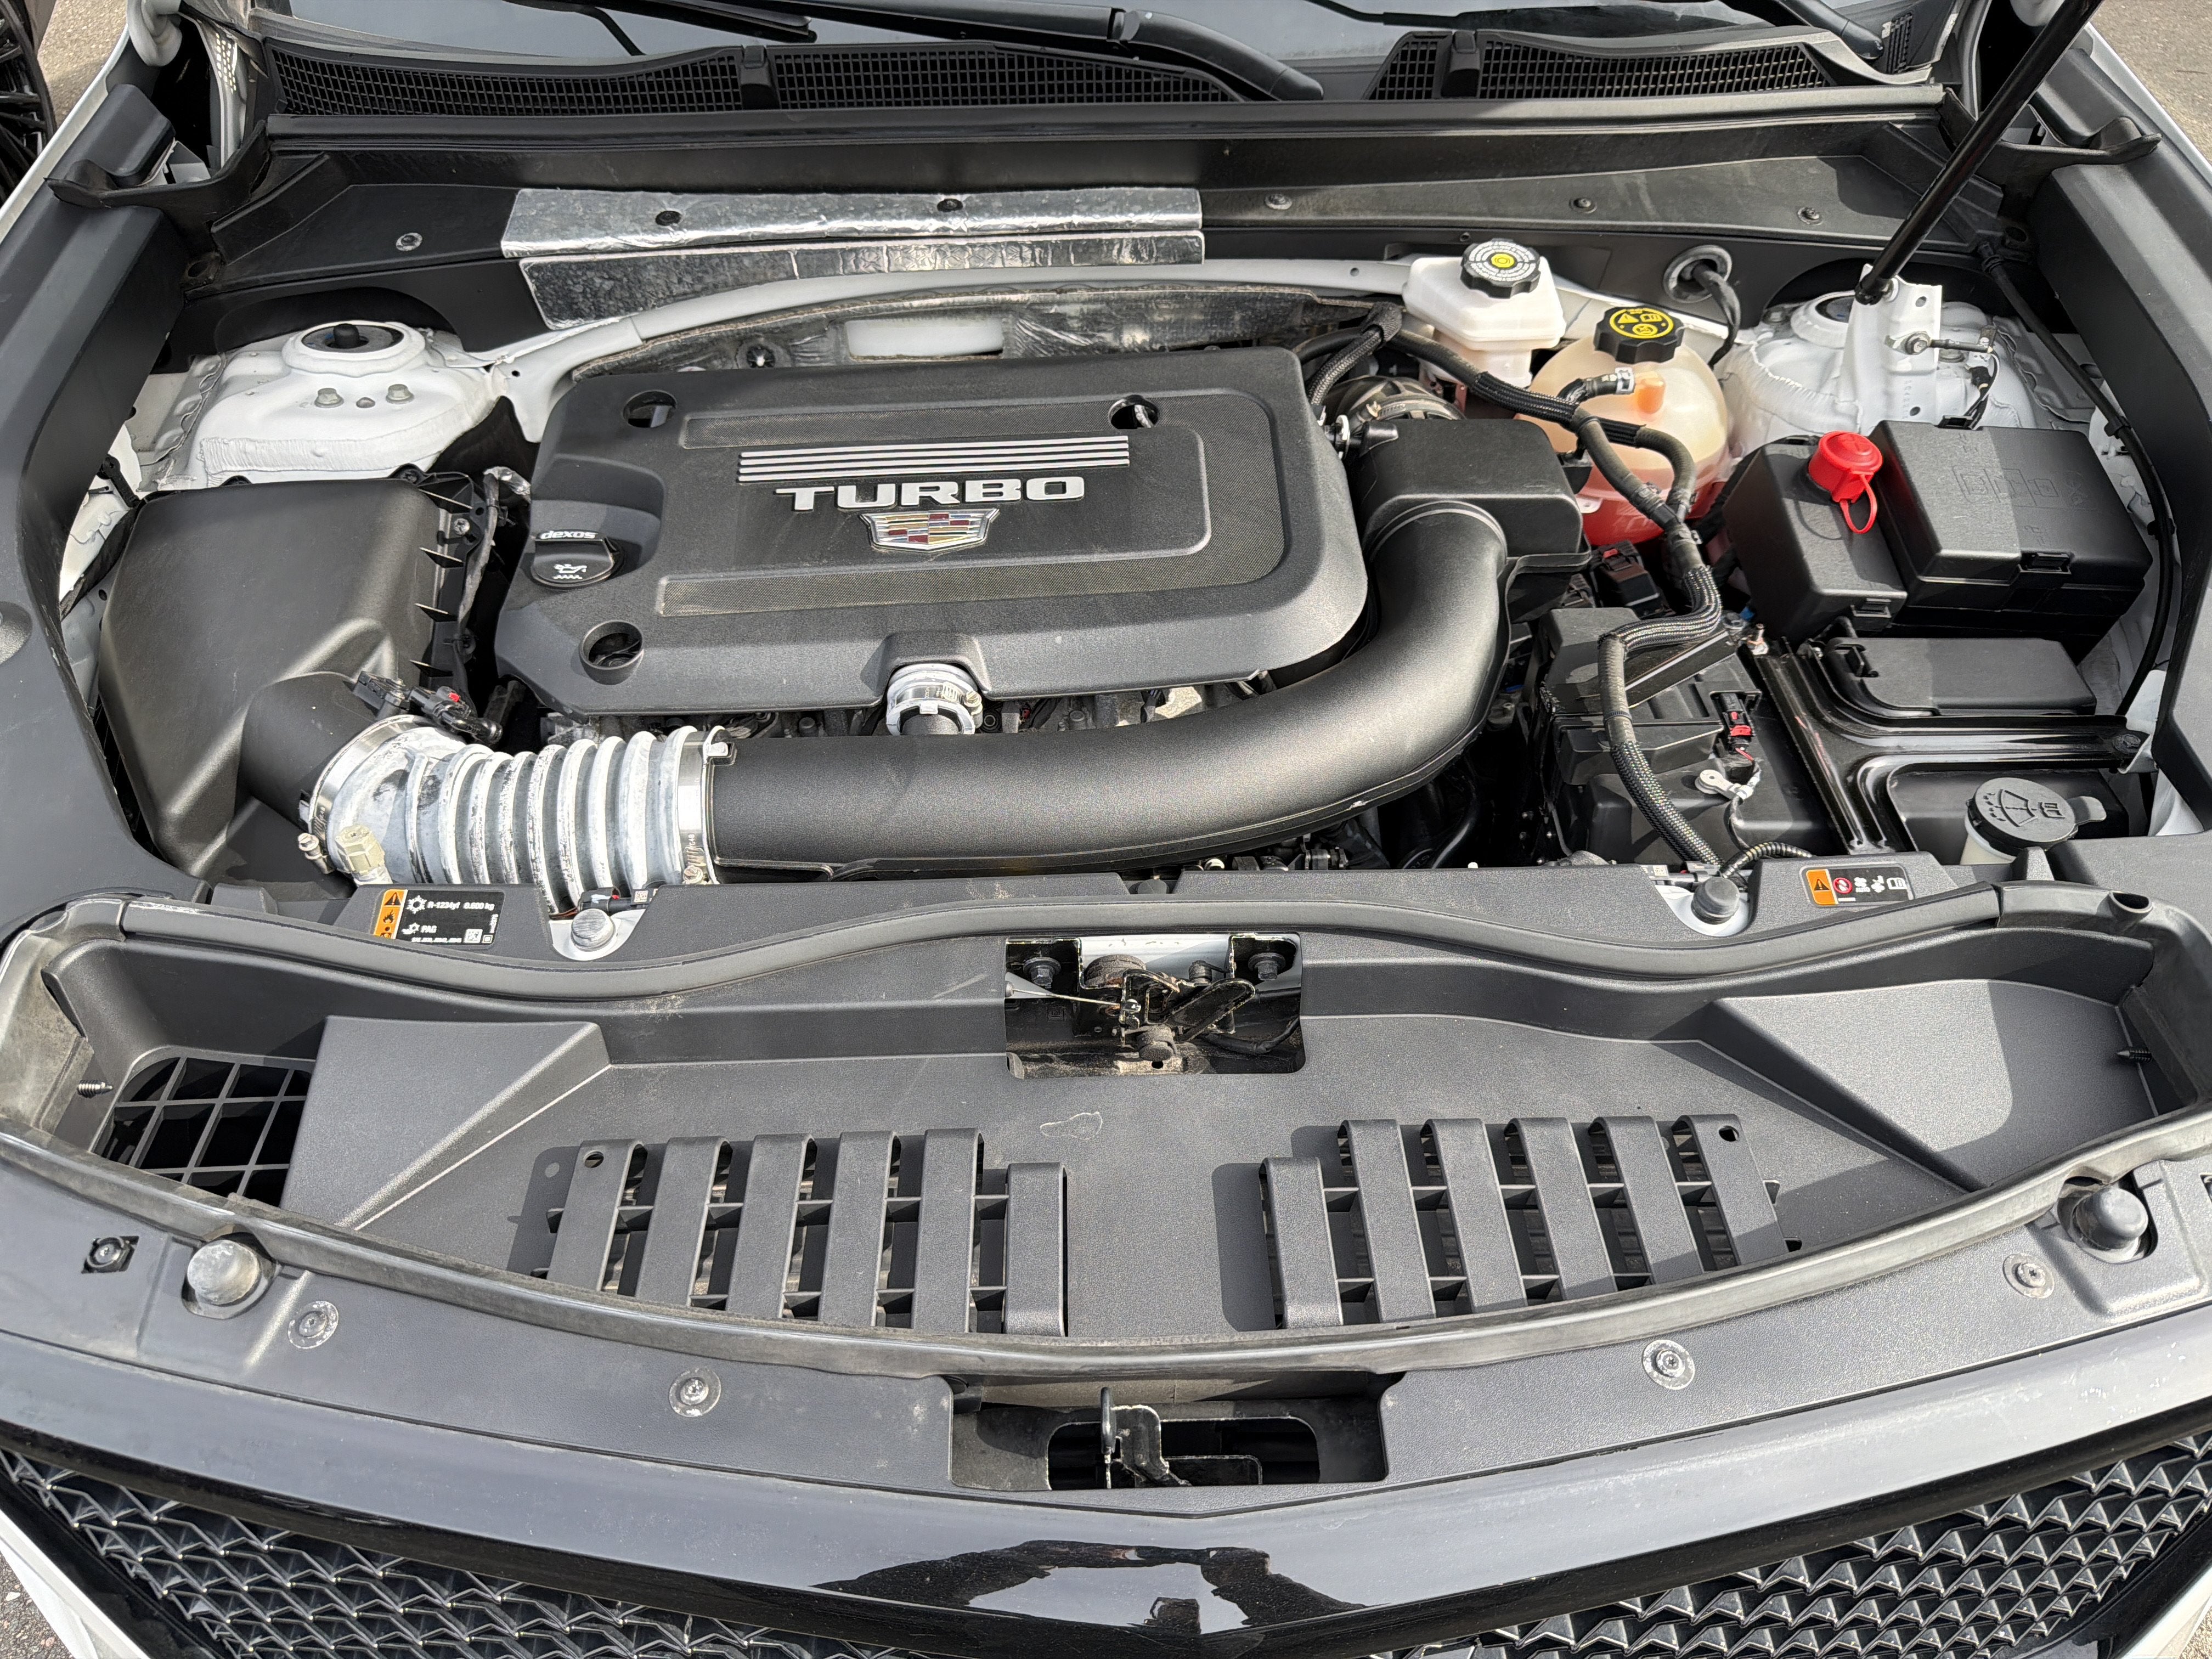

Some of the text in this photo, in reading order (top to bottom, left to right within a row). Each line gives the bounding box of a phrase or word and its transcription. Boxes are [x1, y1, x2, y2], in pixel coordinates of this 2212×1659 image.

[775, 476, 1085, 511] TURBO
[540, 531, 599, 539] dexos
[426, 901, 460, 910] R-1234yf
